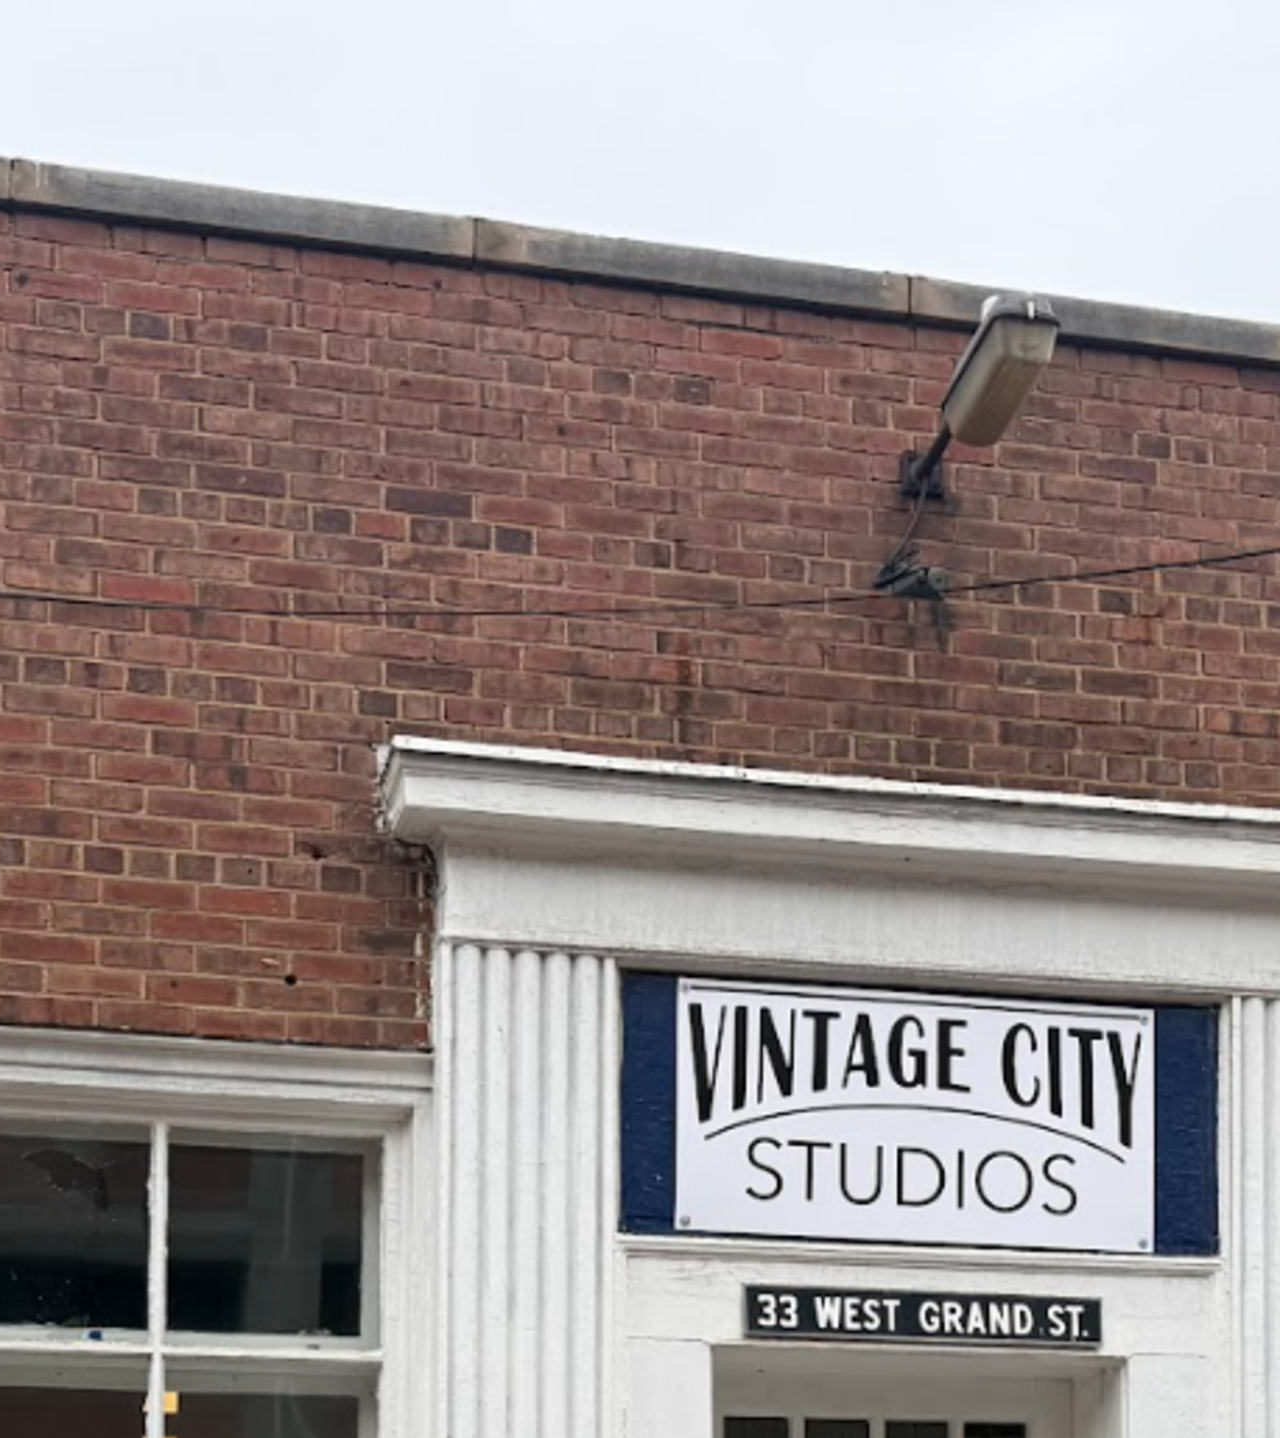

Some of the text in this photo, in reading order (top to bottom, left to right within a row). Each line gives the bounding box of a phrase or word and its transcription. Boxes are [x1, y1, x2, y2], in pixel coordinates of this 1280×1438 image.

[687, 1003, 1142, 1149] VINTAGE CITY
[745, 1137, 1078, 1216] STUDIOS
[757, 1293, 1089, 1338] 33 WEST GRAND ST.
